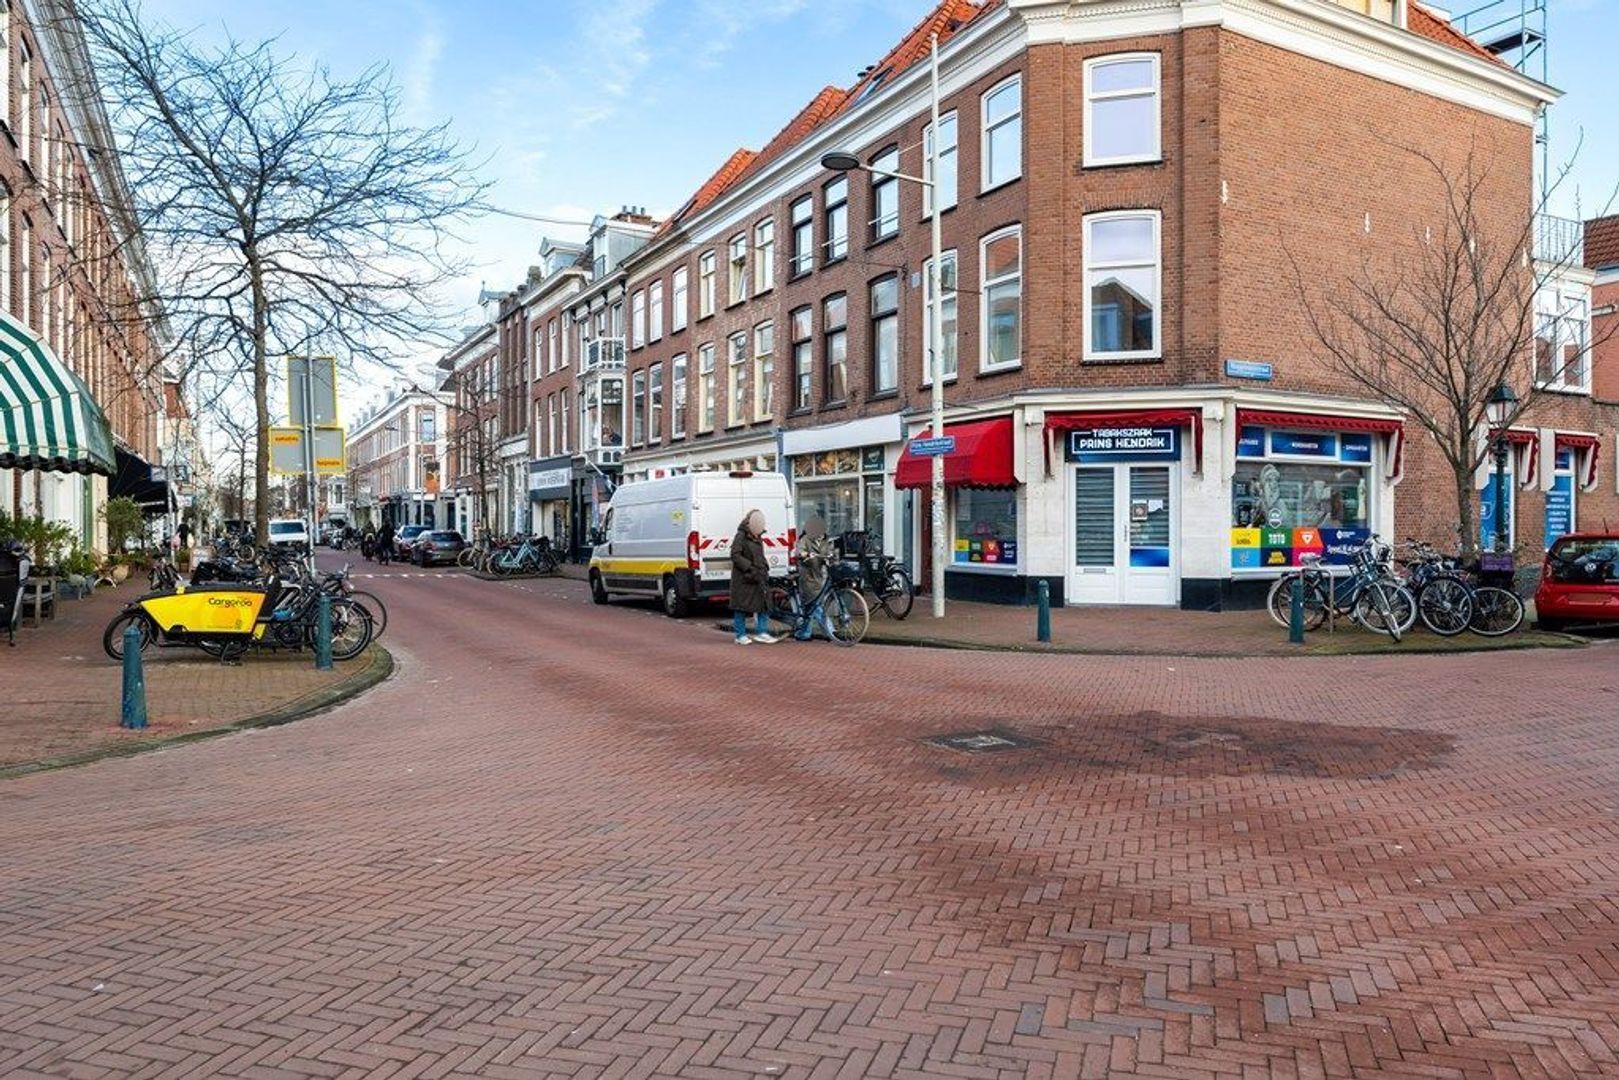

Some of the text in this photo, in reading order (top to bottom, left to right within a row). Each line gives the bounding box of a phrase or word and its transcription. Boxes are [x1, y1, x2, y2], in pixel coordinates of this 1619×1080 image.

[1092, 428, 1152, 437] TABAKSZAAK
[1079, 437, 1165, 449] PRINS HENDRIK
[208, 598, 252, 608] Cargoroo
